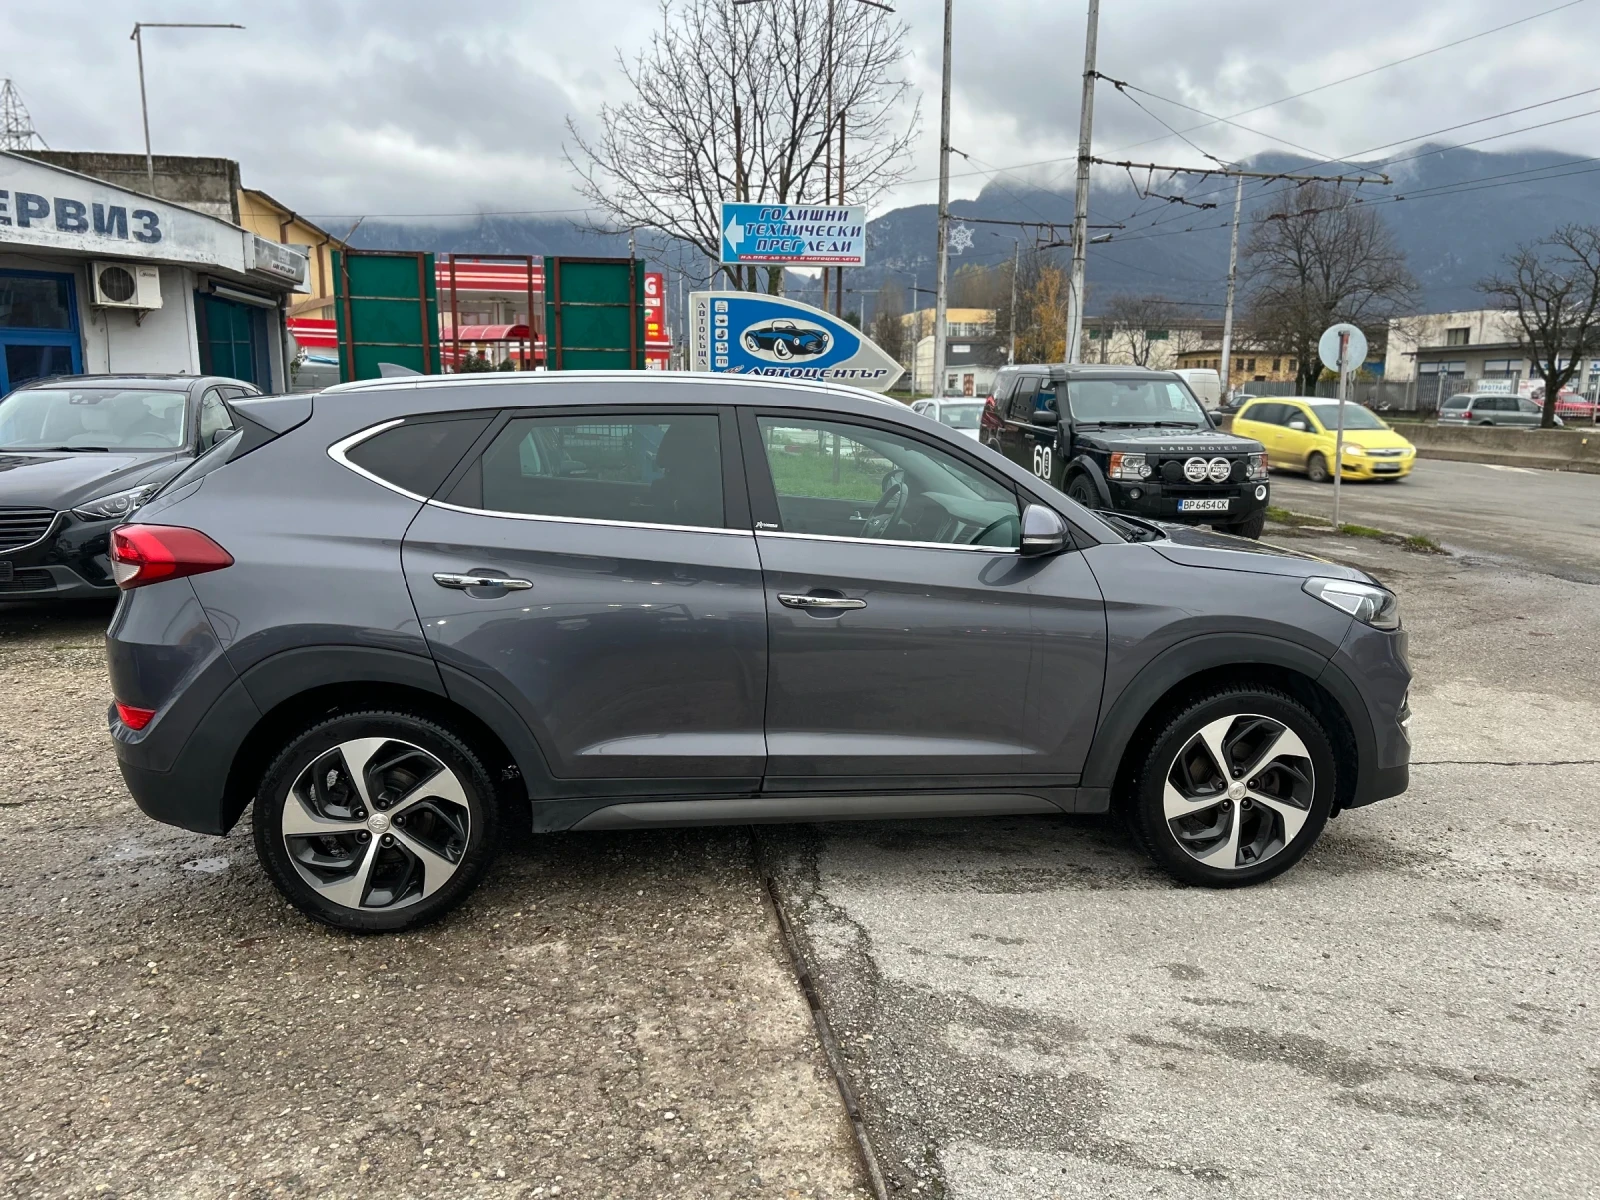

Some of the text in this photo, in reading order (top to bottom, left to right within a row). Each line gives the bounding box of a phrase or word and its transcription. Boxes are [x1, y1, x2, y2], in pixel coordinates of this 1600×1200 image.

[759, 208, 849, 222] ГОДИШНИ
[746, 223, 862, 238] ТЕХНИЧЕСКИ
[756, 238, 852, 252] ПРЕГЛЕДИ
[698, 302, 707, 366] АВТОКЪЩА
[748, 366, 888, 380] АВТОЦЕНТЪР
[1034, 444, 1052, 480] 60
[1184, 501, 1227, 509] BP 6454 CK
